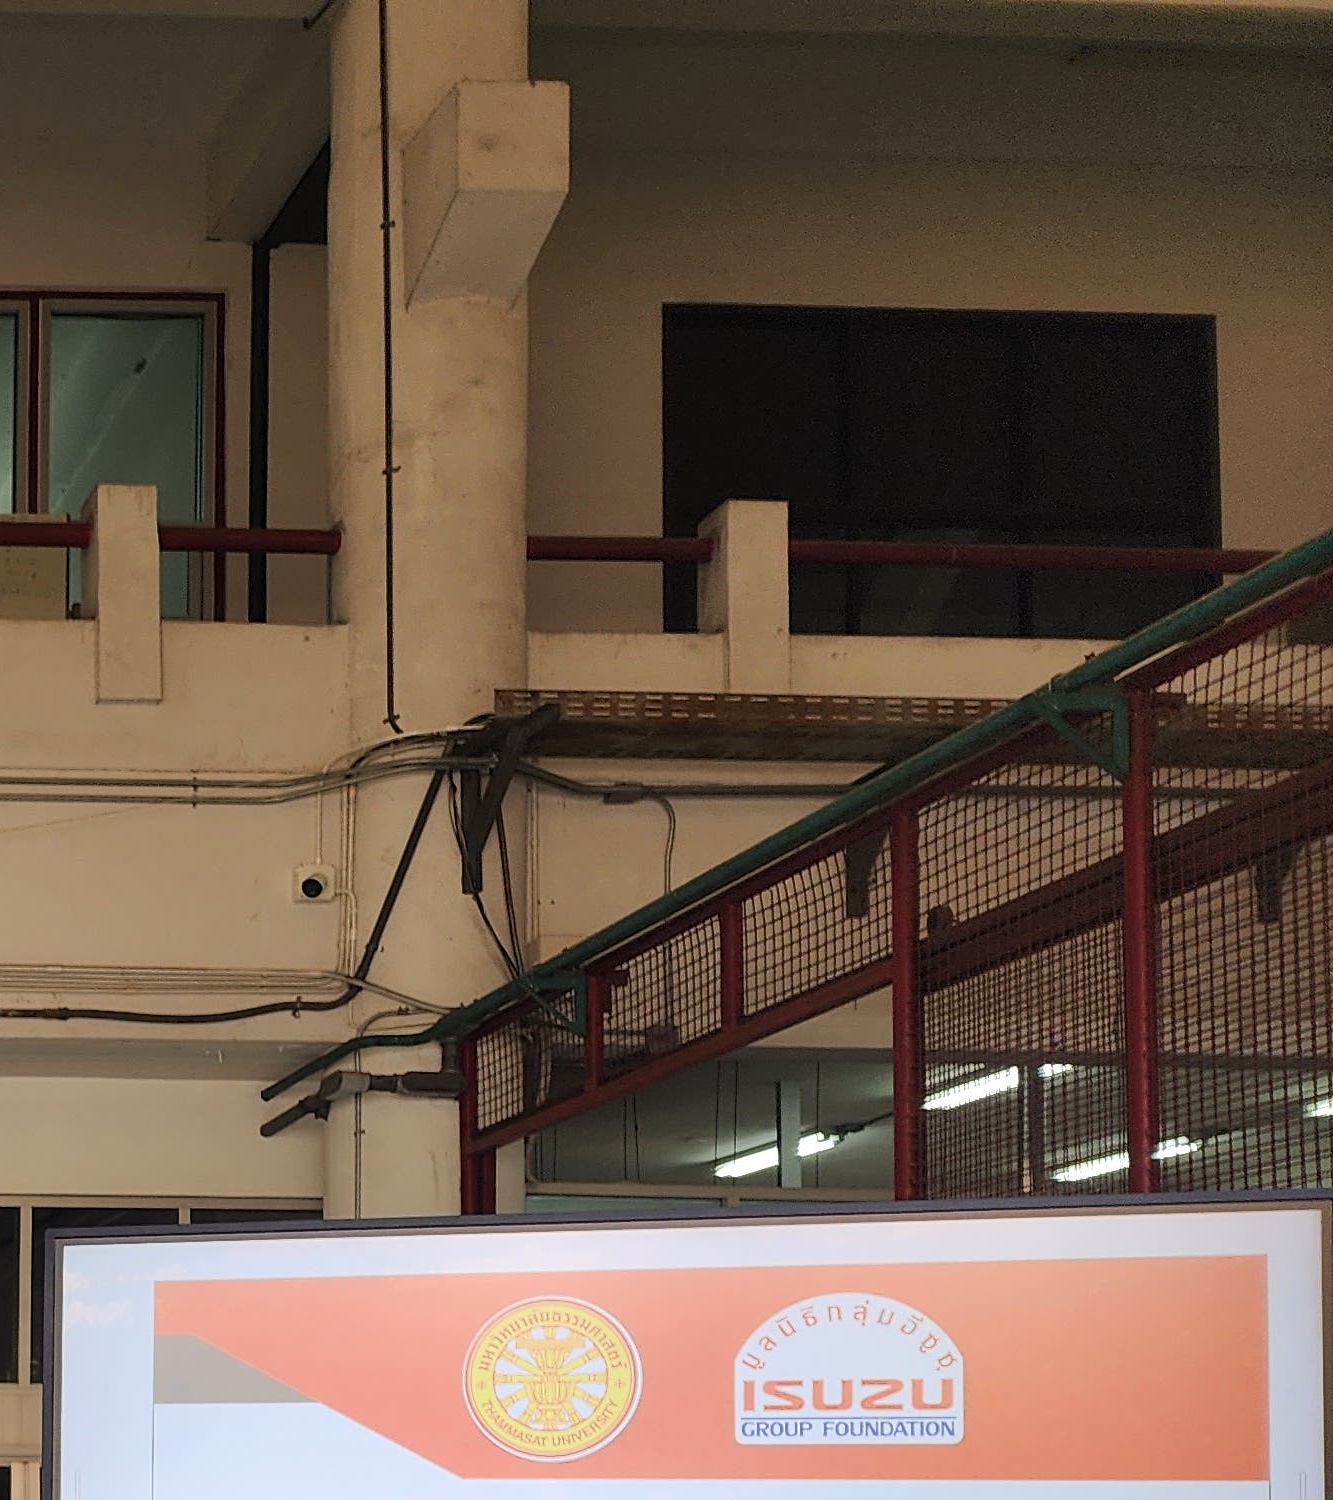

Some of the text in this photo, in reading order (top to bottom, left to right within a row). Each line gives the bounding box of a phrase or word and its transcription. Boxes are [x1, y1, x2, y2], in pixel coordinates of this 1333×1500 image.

[743, 1378, 954, 1412] ISUZU
[483, 1400, 620, 1446] THAMMASAT UNIVERSITY
[741, 1420, 955, 1437] GROUP FOUNDATION
